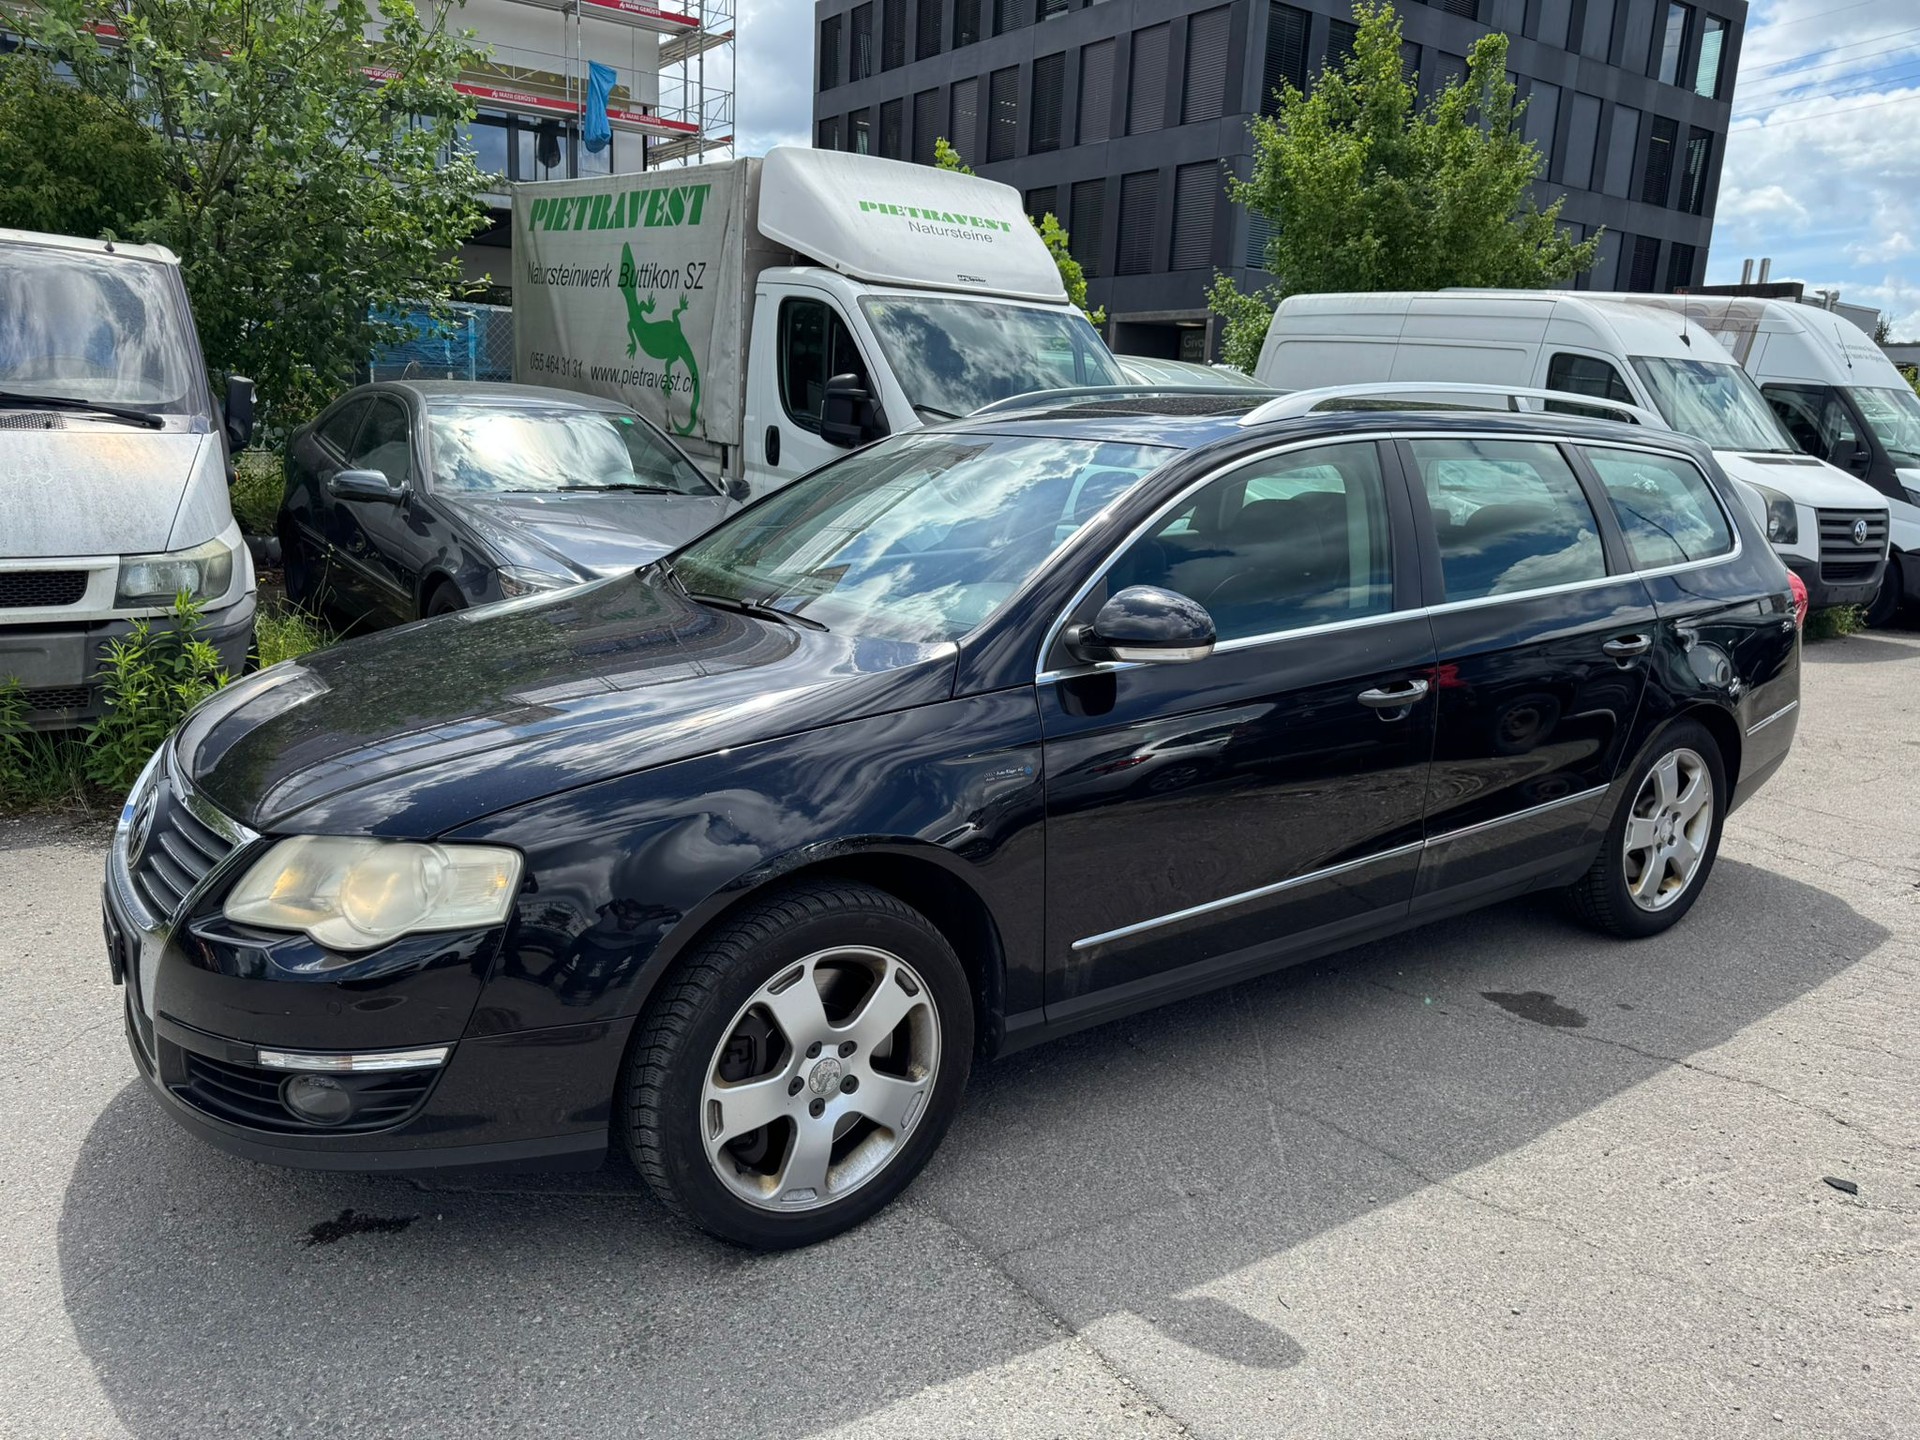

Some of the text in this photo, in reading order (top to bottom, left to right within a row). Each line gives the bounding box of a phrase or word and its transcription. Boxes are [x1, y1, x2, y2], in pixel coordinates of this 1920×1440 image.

[528, 184, 712, 231] PIETRAVEST
[858, 200, 1011, 232] PIETRAVEST
[908, 220, 993, 243] Natursteine
[527, 261, 707, 290] Natursteinwerk Buttikon SZ
[530, 352, 583, 379] 055 464 31 31
[590, 364, 698, 394] www.pietravest.ch
